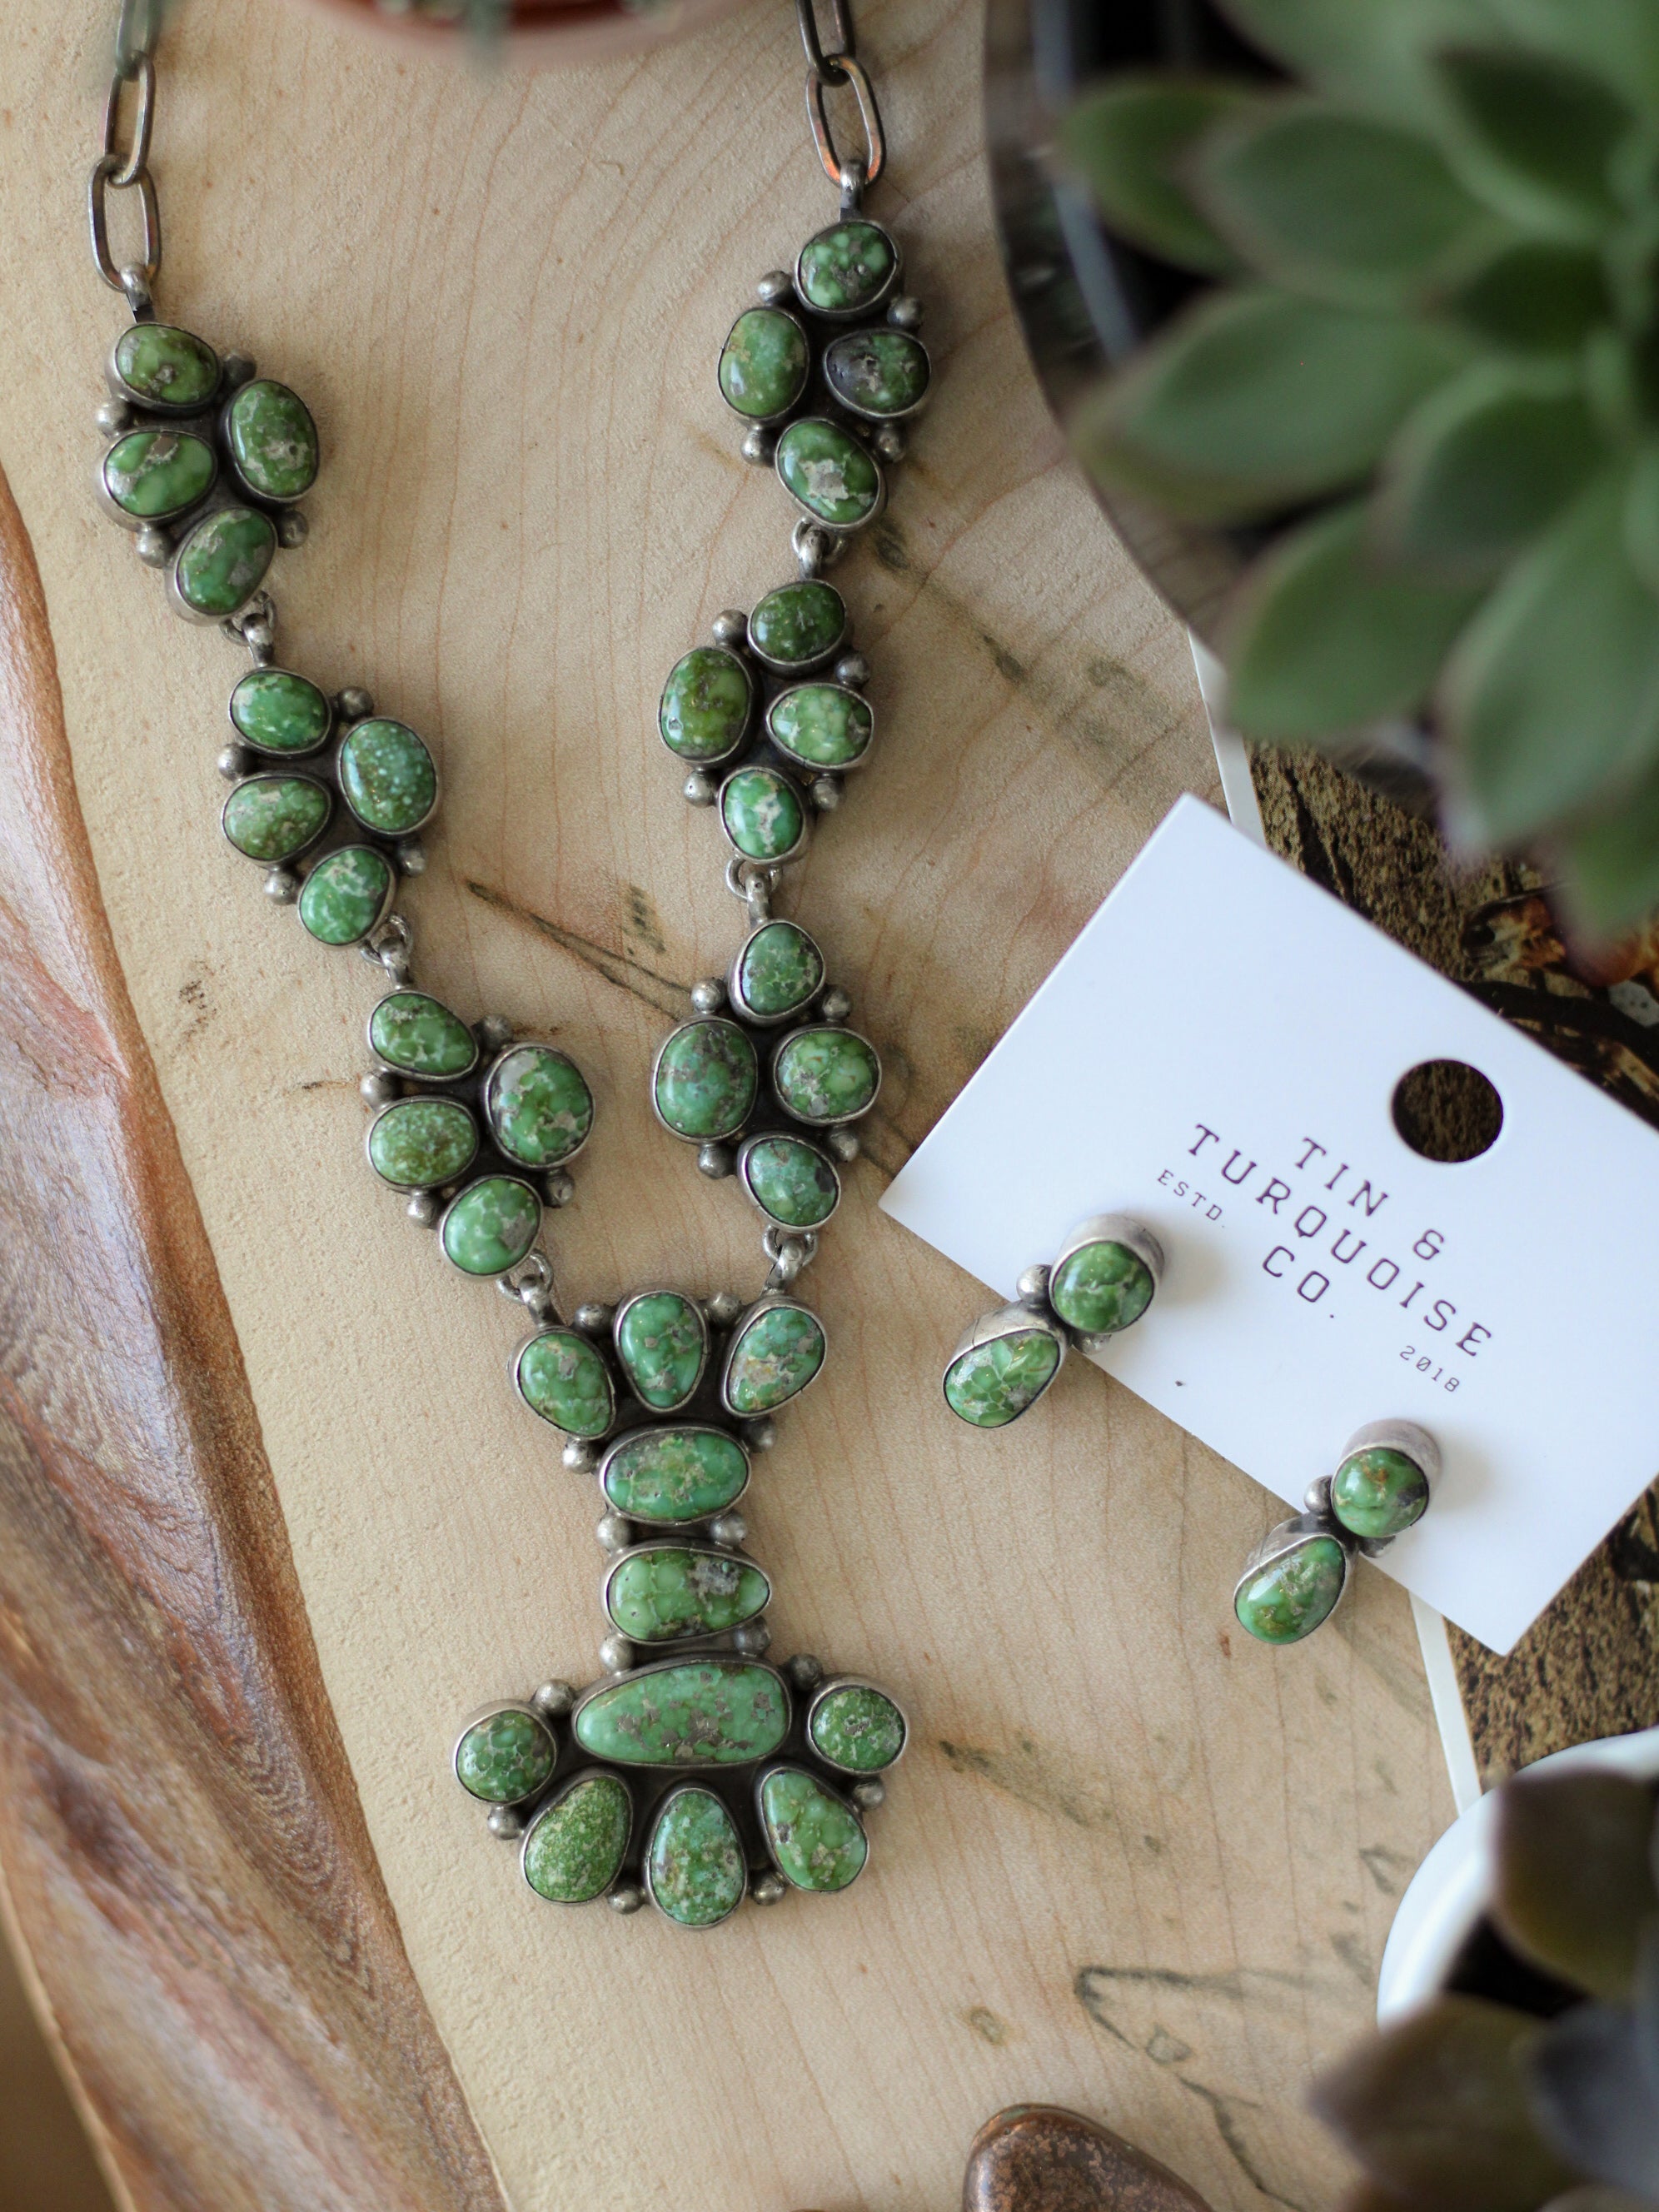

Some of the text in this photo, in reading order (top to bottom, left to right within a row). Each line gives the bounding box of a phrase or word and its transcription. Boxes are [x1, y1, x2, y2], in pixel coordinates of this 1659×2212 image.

[1157, 1168, 1225, 1228] ESTD.
[1295, 1138, 1445, 1261] TIN &
[1188, 1123, 1492, 1357] TURQUOISE
[1263, 1246, 1334, 1318] CO.
[1399, 1345, 1460, 1392] 2018
